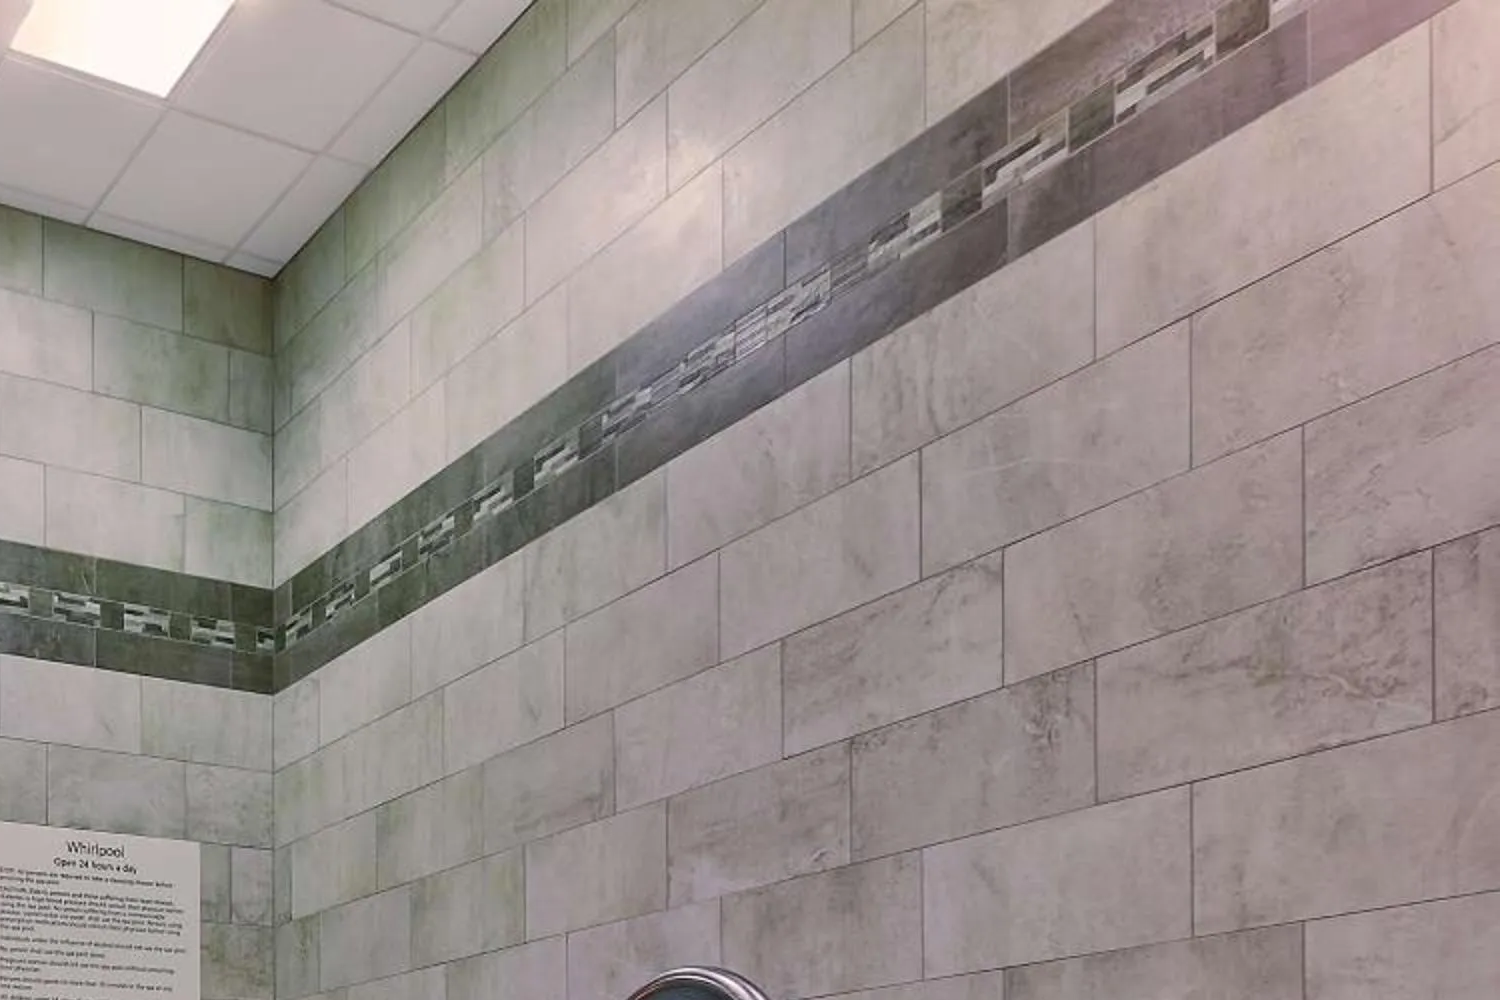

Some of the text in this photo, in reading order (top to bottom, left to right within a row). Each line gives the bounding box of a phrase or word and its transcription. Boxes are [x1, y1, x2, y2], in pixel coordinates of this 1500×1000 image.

[66, 840, 125, 858] Whirlpool
[53, 857, 77, 869] Open
[79, 859, 89, 870] 24
[91, 861, 114, 872] hours
[122, 864, 137, 875] day
